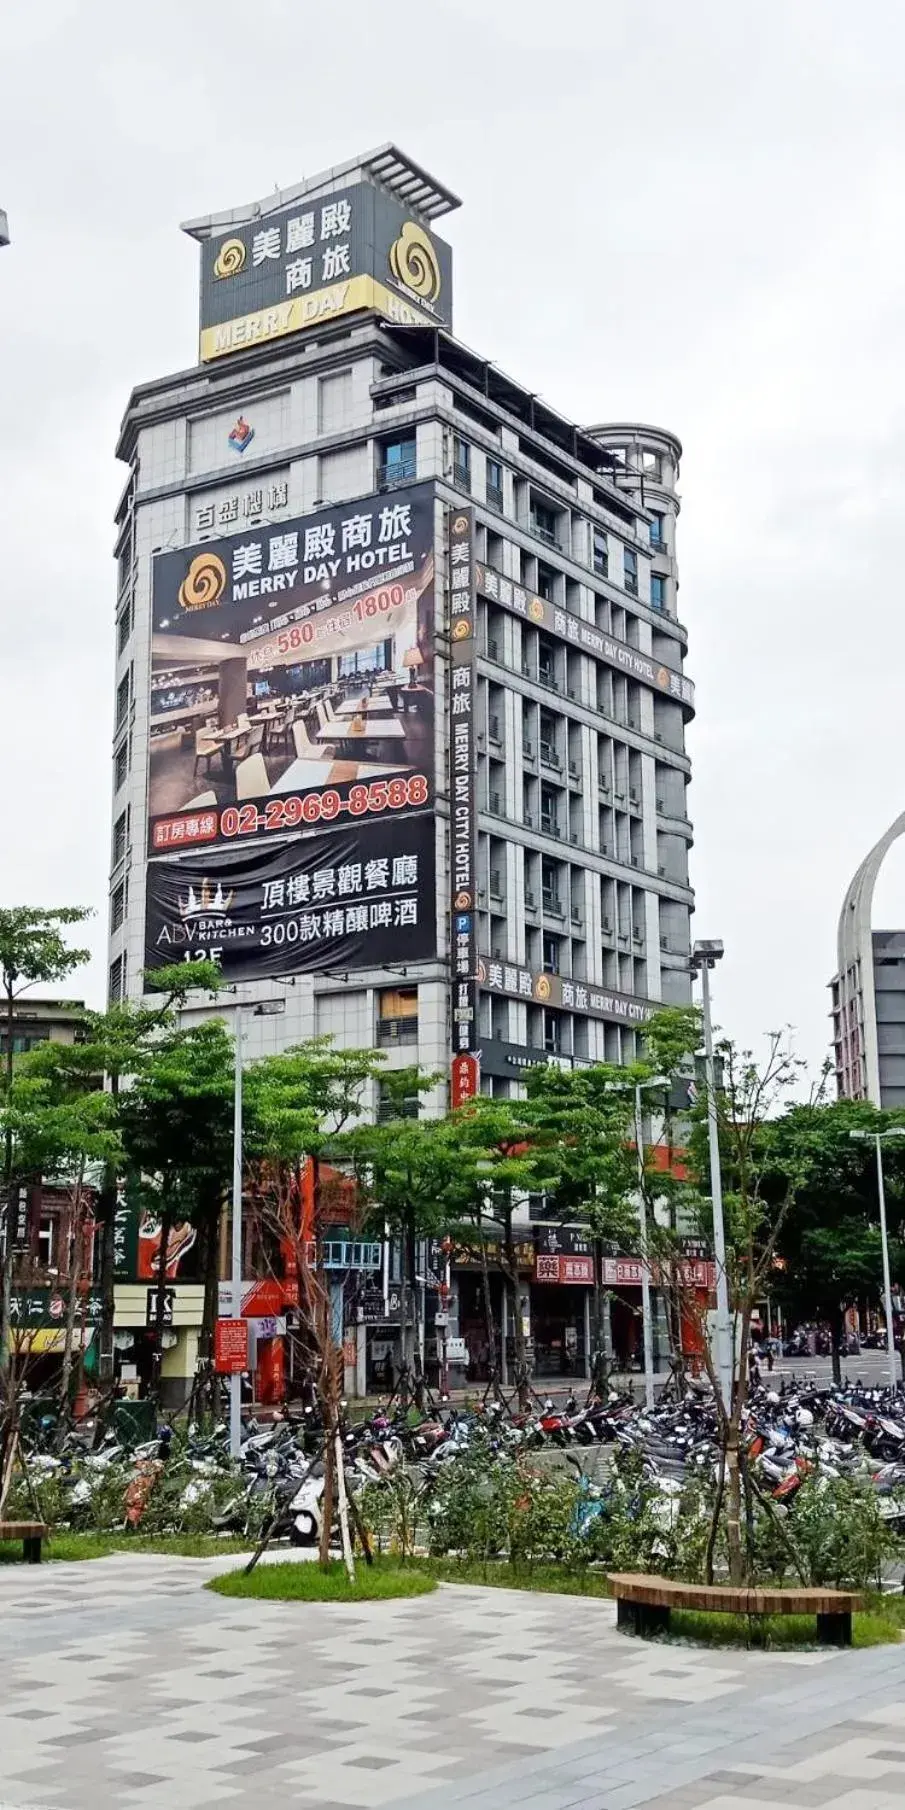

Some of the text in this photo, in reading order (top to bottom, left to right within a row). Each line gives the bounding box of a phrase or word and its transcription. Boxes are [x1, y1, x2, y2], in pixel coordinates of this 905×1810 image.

[252, 199, 352, 267] 美麗殿
[285, 244, 350, 295] 商旅
[214, 301, 294, 353] MERRY
[303, 284, 350, 322] DAY
[232, 504, 413, 580] 美麗殿商旅
[232, 543, 413, 602] MERRY DAY HOTEL
[451, 541, 471, 614] 美麗殿
[484, 572, 527, 614] 美麗殿
[277, 621, 315, 655] 580
[352, 583, 405, 622] 1800
[554, 610, 579, 643] 商旅
[580, 628, 603, 653] MERRY
[618, 648, 633, 669] CITY
[452, 666, 471, 715] 商旅
[156, 775, 428, 844] 訂房專線 02-2969-8588
[454, 722, 470, 891] MERRY DAY CITY HOTEL
[260, 853, 419, 911] 頂樓景觀餐廳
[198, 925, 256, 941] KITCHEN
[260, 898, 418, 947] 300款精釀啤酒
[489, 964, 533, 997] 美麗殿
[562, 982, 588, 1010] 商旅
[590, 993, 614, 1012] MERRY
[628, 1003, 644, 1021] CITY
